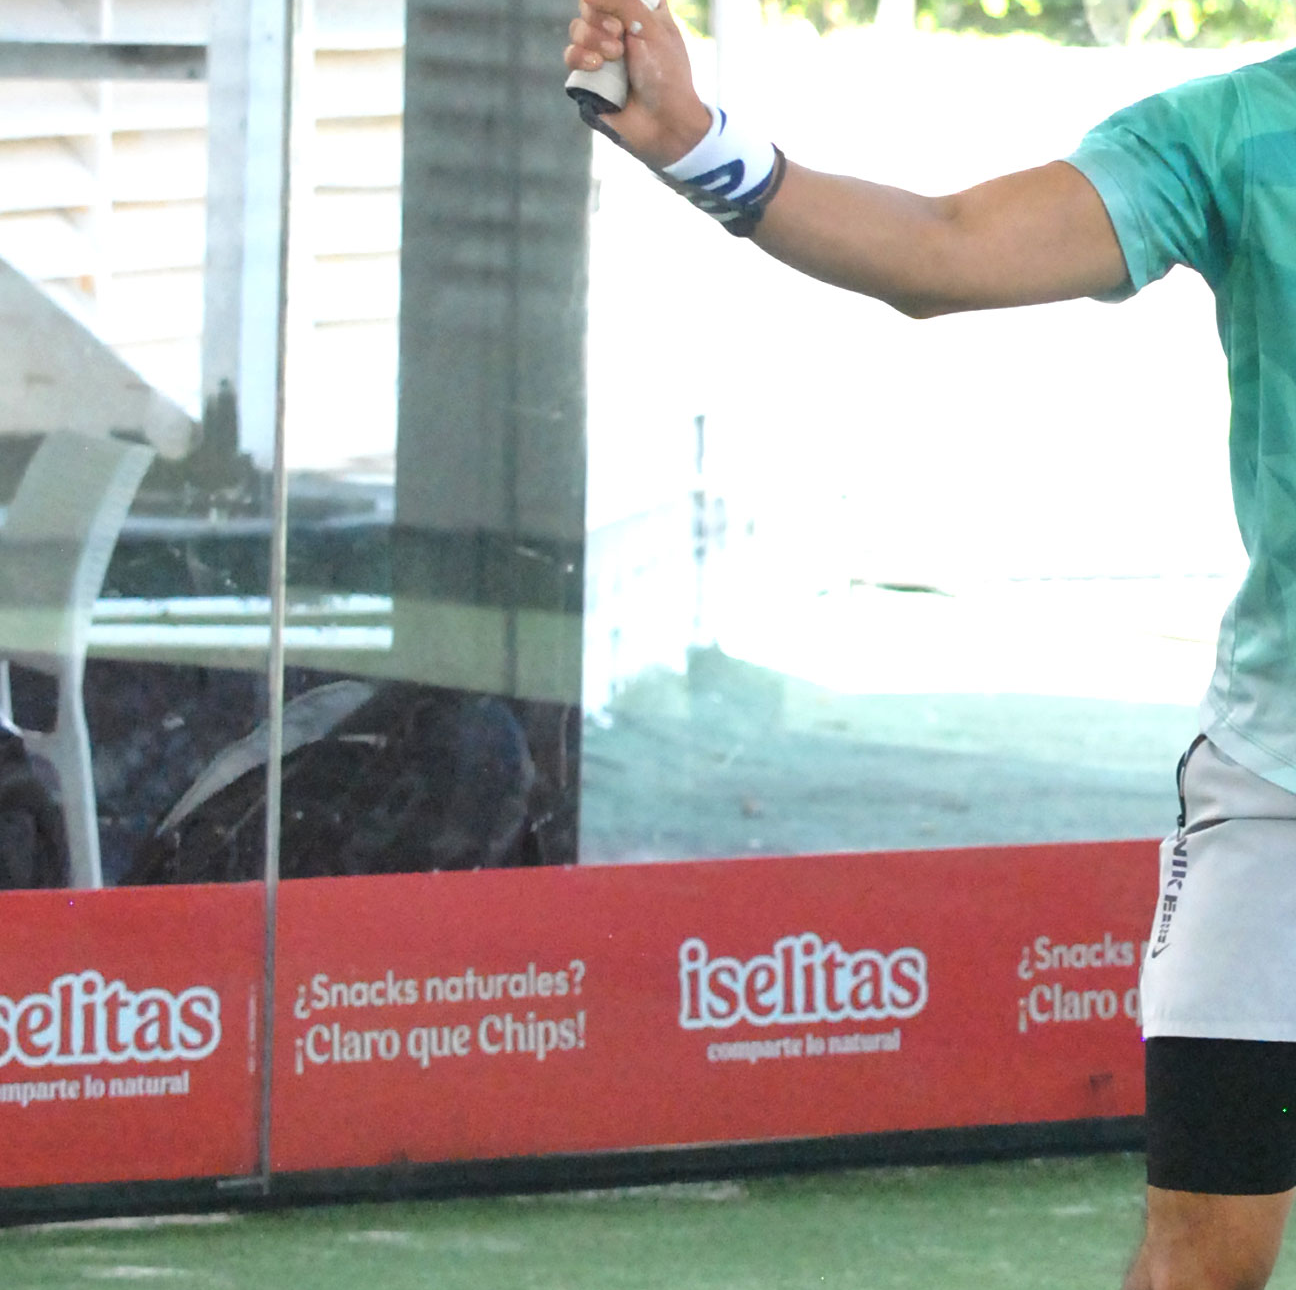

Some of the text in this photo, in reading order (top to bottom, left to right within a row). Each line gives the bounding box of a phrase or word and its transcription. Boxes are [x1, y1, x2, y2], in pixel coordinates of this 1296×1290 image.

[679, 932, 928, 1029] iselitas
[1018, 932, 1134, 980] ¿Snacks
[0, 969, 222, 1068] elitas
[293, 959, 586, 1020] ¿Snacks naturales?
[1018, 982, 1118, 1033] ¡Claro
[295, 1022, 401, 1075] ¡Claro
[407, 1024, 472, 1069] que
[478, 1010, 587, 1061] Chips!
[84, 1074, 105, 1099] lo
[109, 1070, 190, 1098] natural
